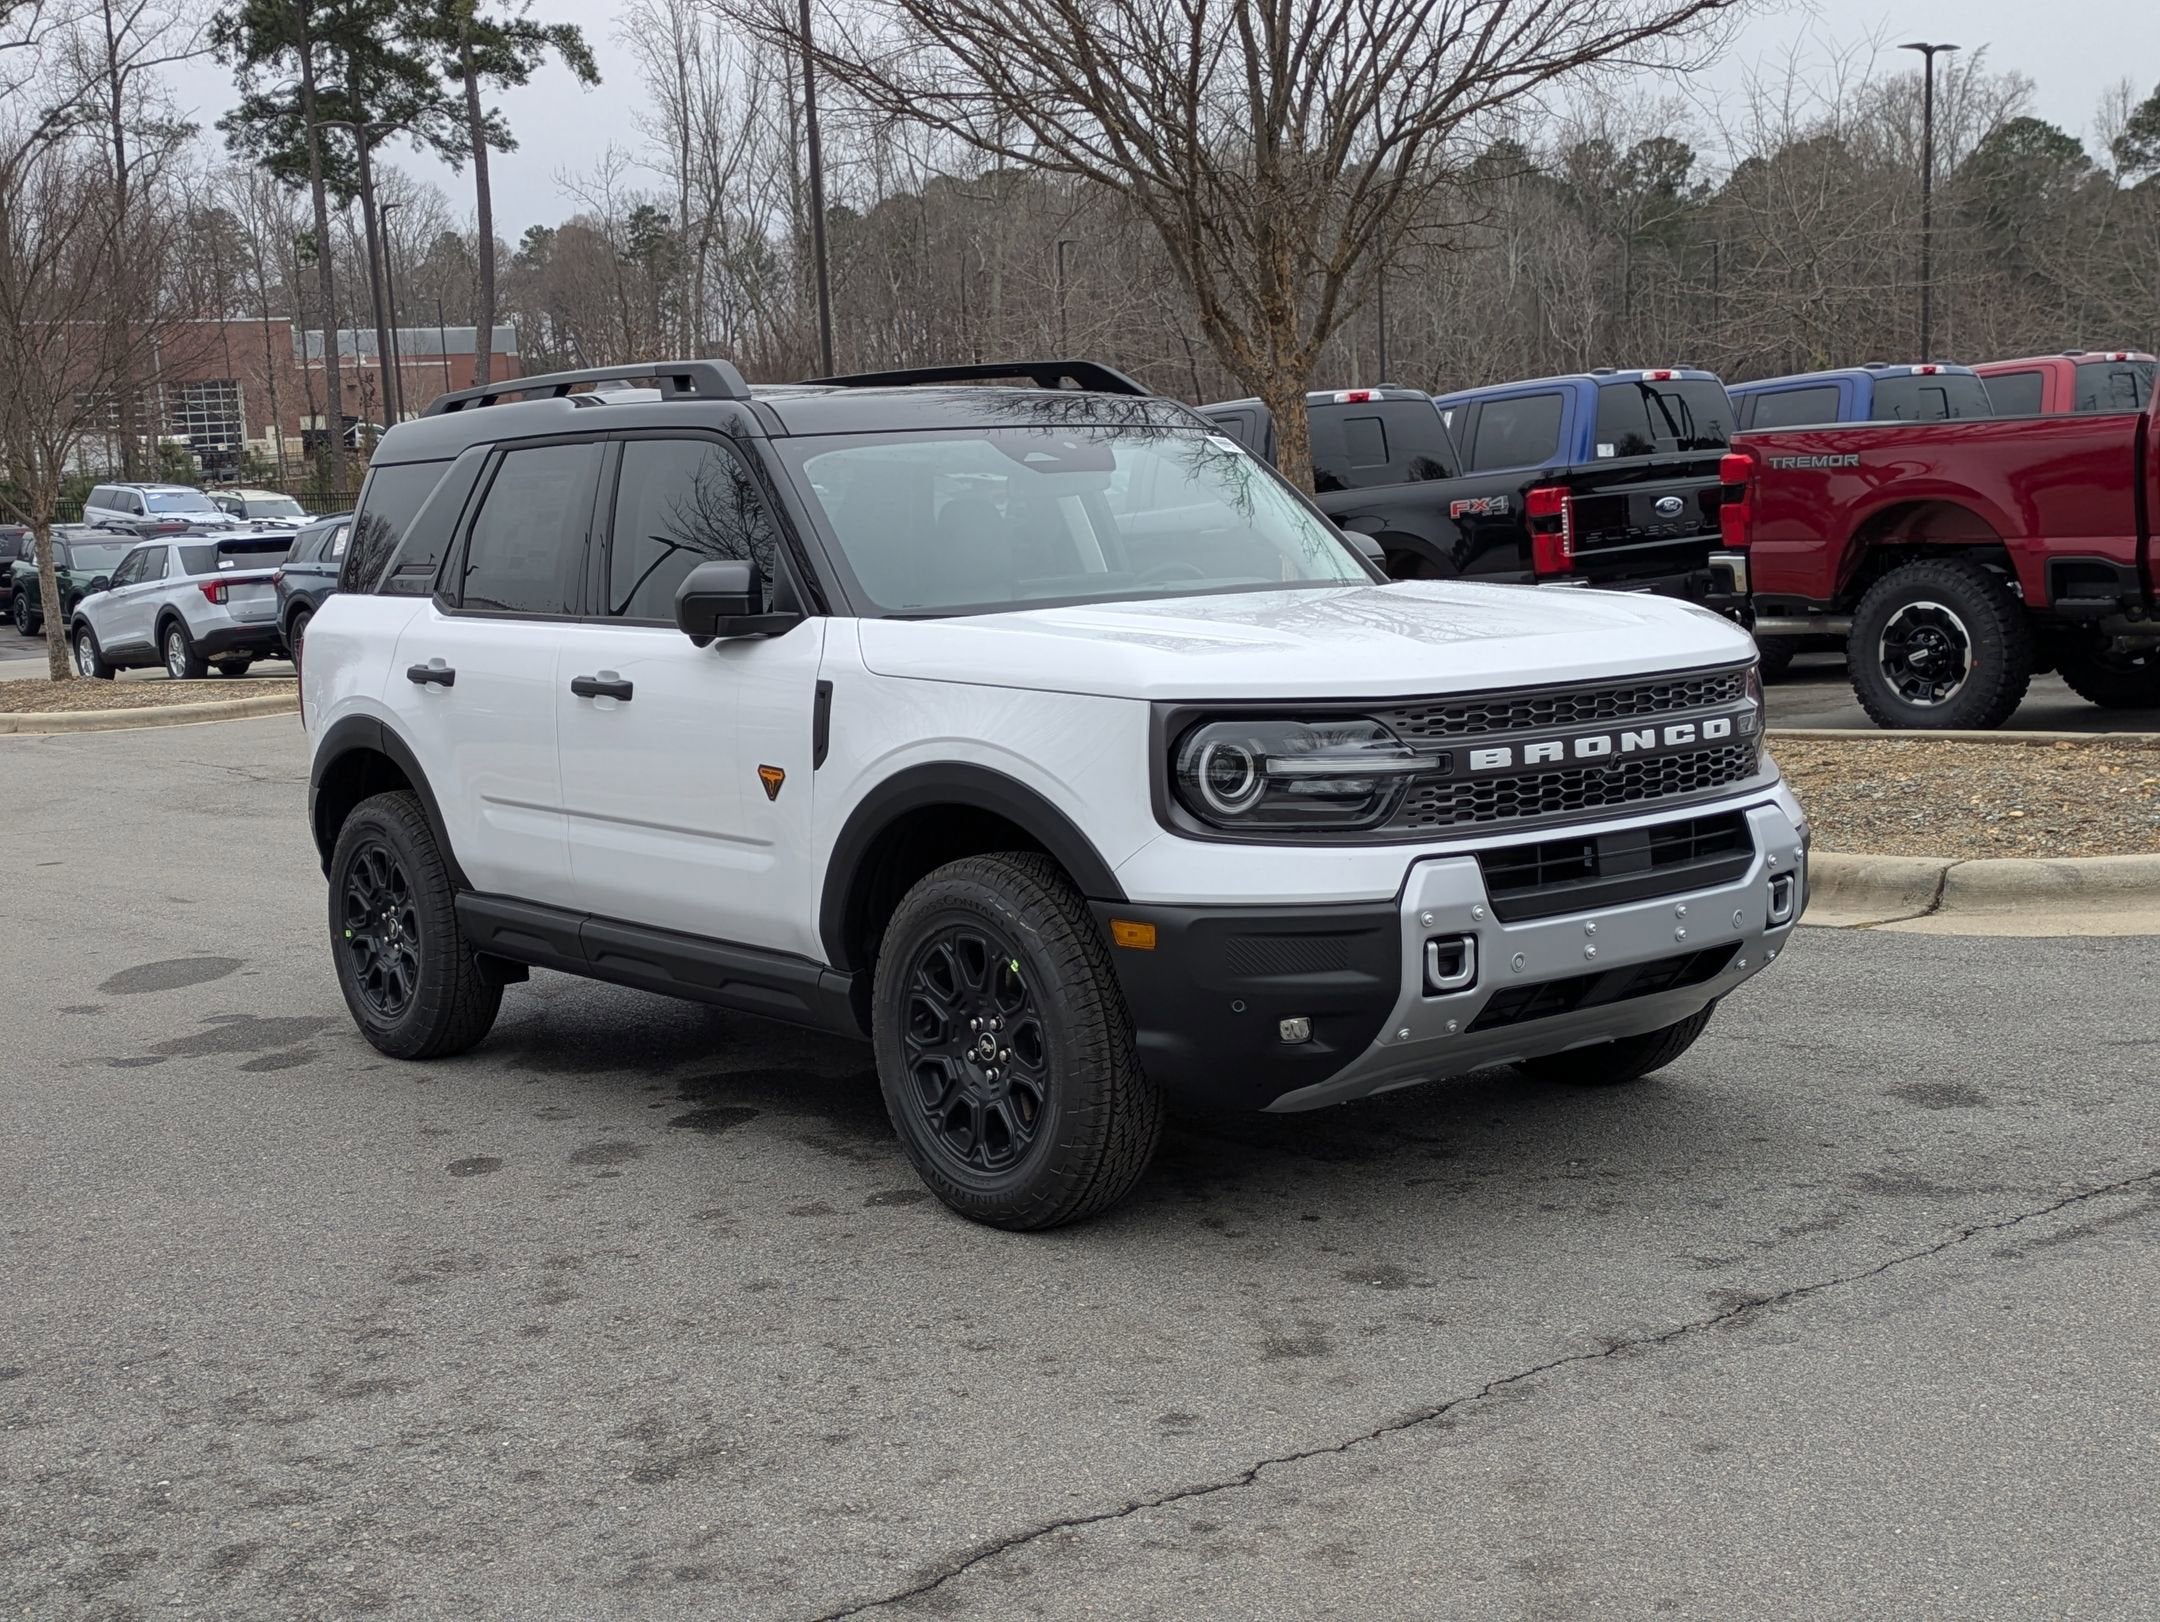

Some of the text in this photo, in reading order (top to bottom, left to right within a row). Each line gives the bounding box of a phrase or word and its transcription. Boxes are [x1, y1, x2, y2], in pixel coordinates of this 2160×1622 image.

[1769, 454, 1860, 469] TREMOR
[1450, 495, 1509, 519] FX4
[1585, 520, 1719, 543] SUPER DU
[1469, 718, 1731, 771] BRONCO
